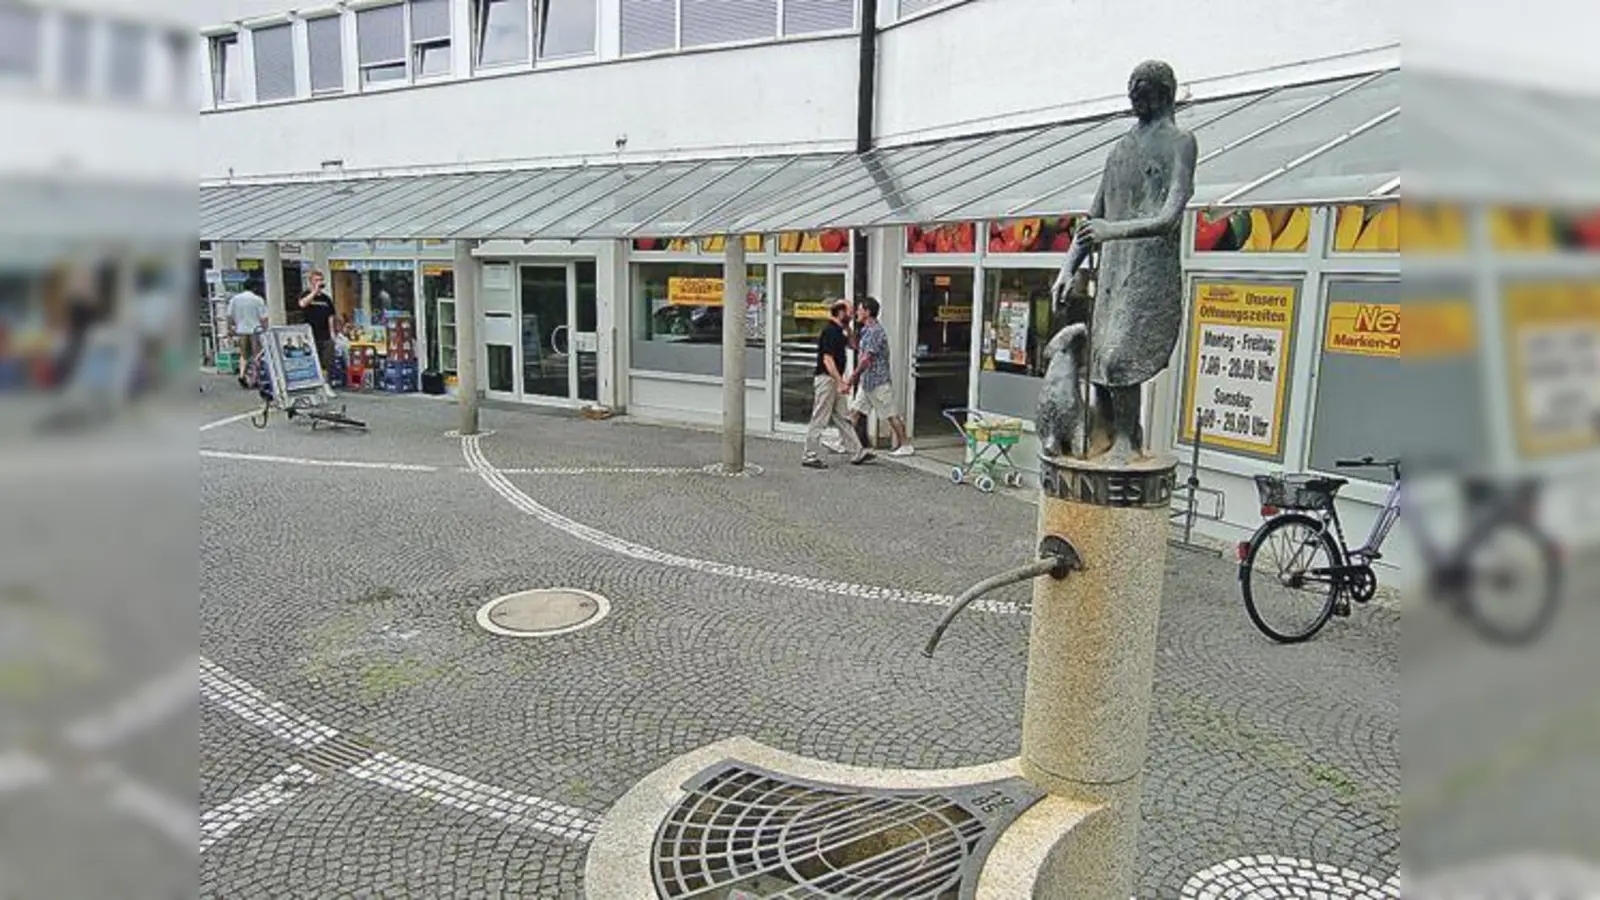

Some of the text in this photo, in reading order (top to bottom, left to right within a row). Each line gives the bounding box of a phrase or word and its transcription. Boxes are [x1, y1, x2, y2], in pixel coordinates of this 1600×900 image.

[1245, 292, 1288, 308] Unsere
[1200, 303, 1286, 322] Öffnungszeiten
[1354, 304, 1400, 333] Ne
[1204, 329, 1235, 352] Montag
[1257, 358, 1275, 382] Uhr
[1252, 415, 1269, 437] Uhr
